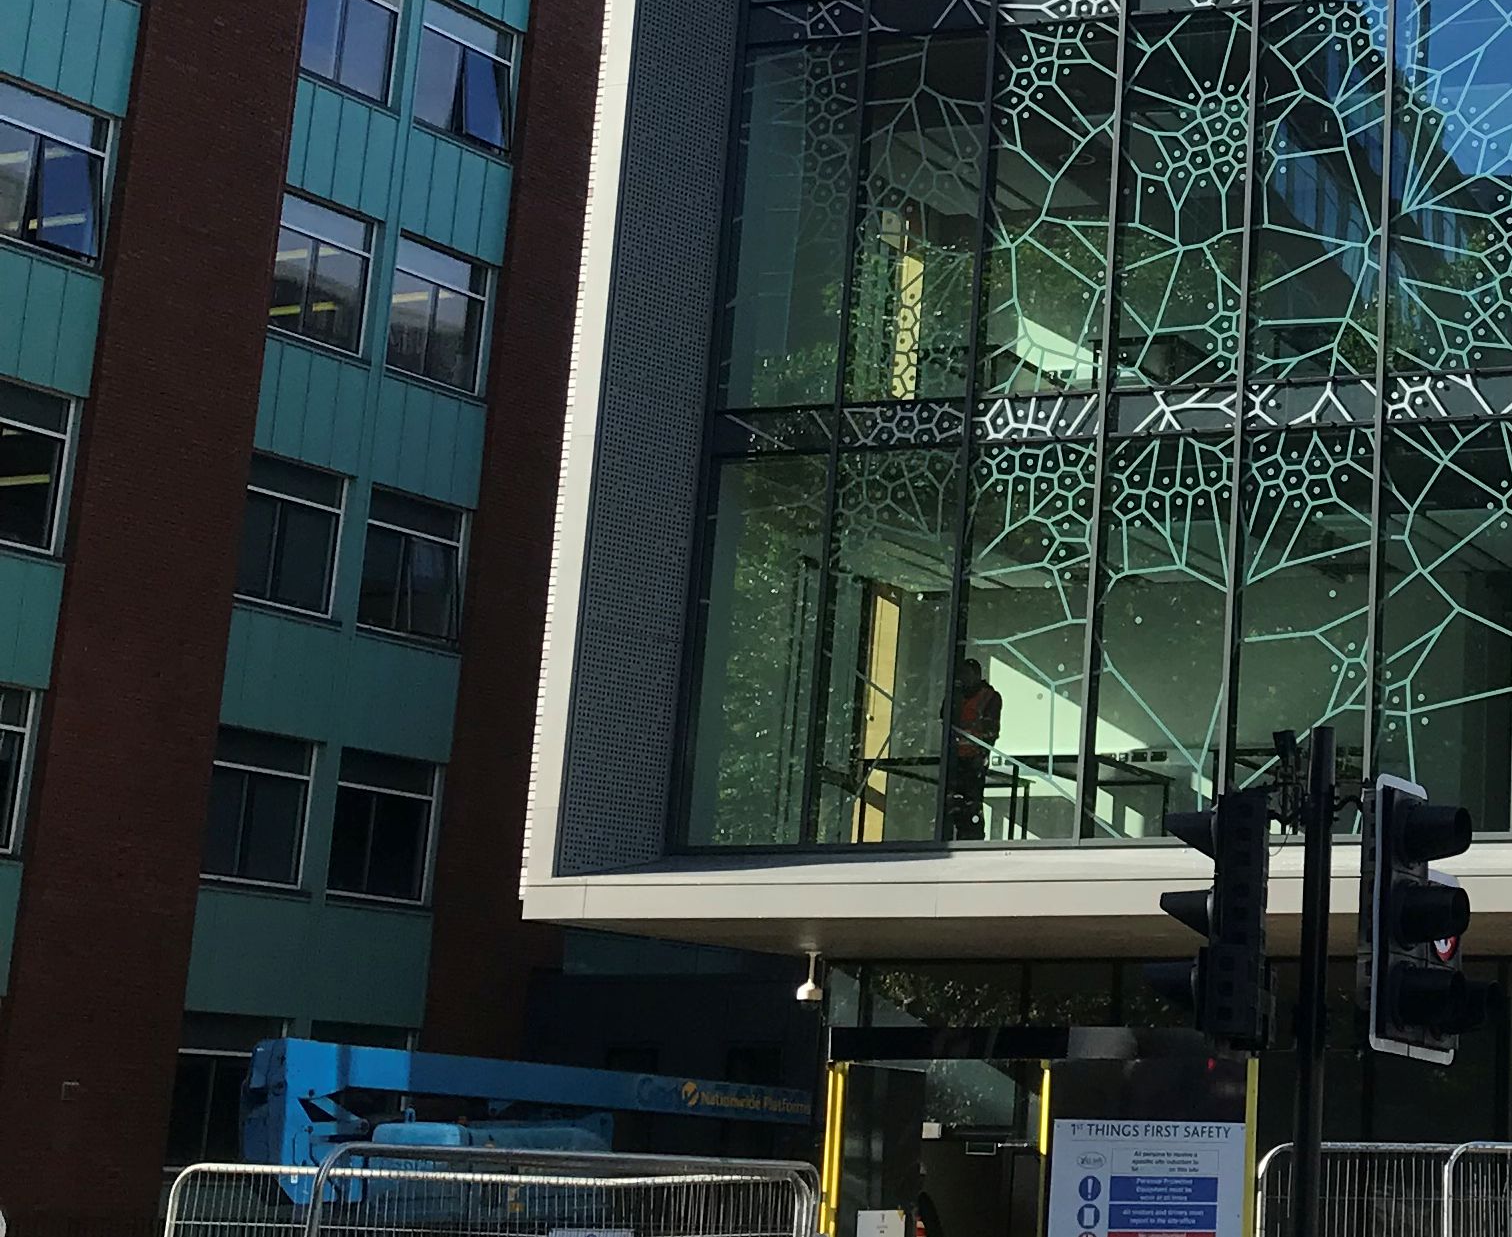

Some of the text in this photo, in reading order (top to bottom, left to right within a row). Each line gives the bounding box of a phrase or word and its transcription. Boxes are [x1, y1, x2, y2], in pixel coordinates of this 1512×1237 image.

[700, 1091, 761, 1110] Nationwide
[1087, 1123, 1140, 1137] THINGS
[1144, 1124, 1180, 1138] FIRST
[1183, 1125, 1231, 1139] SAFETY
